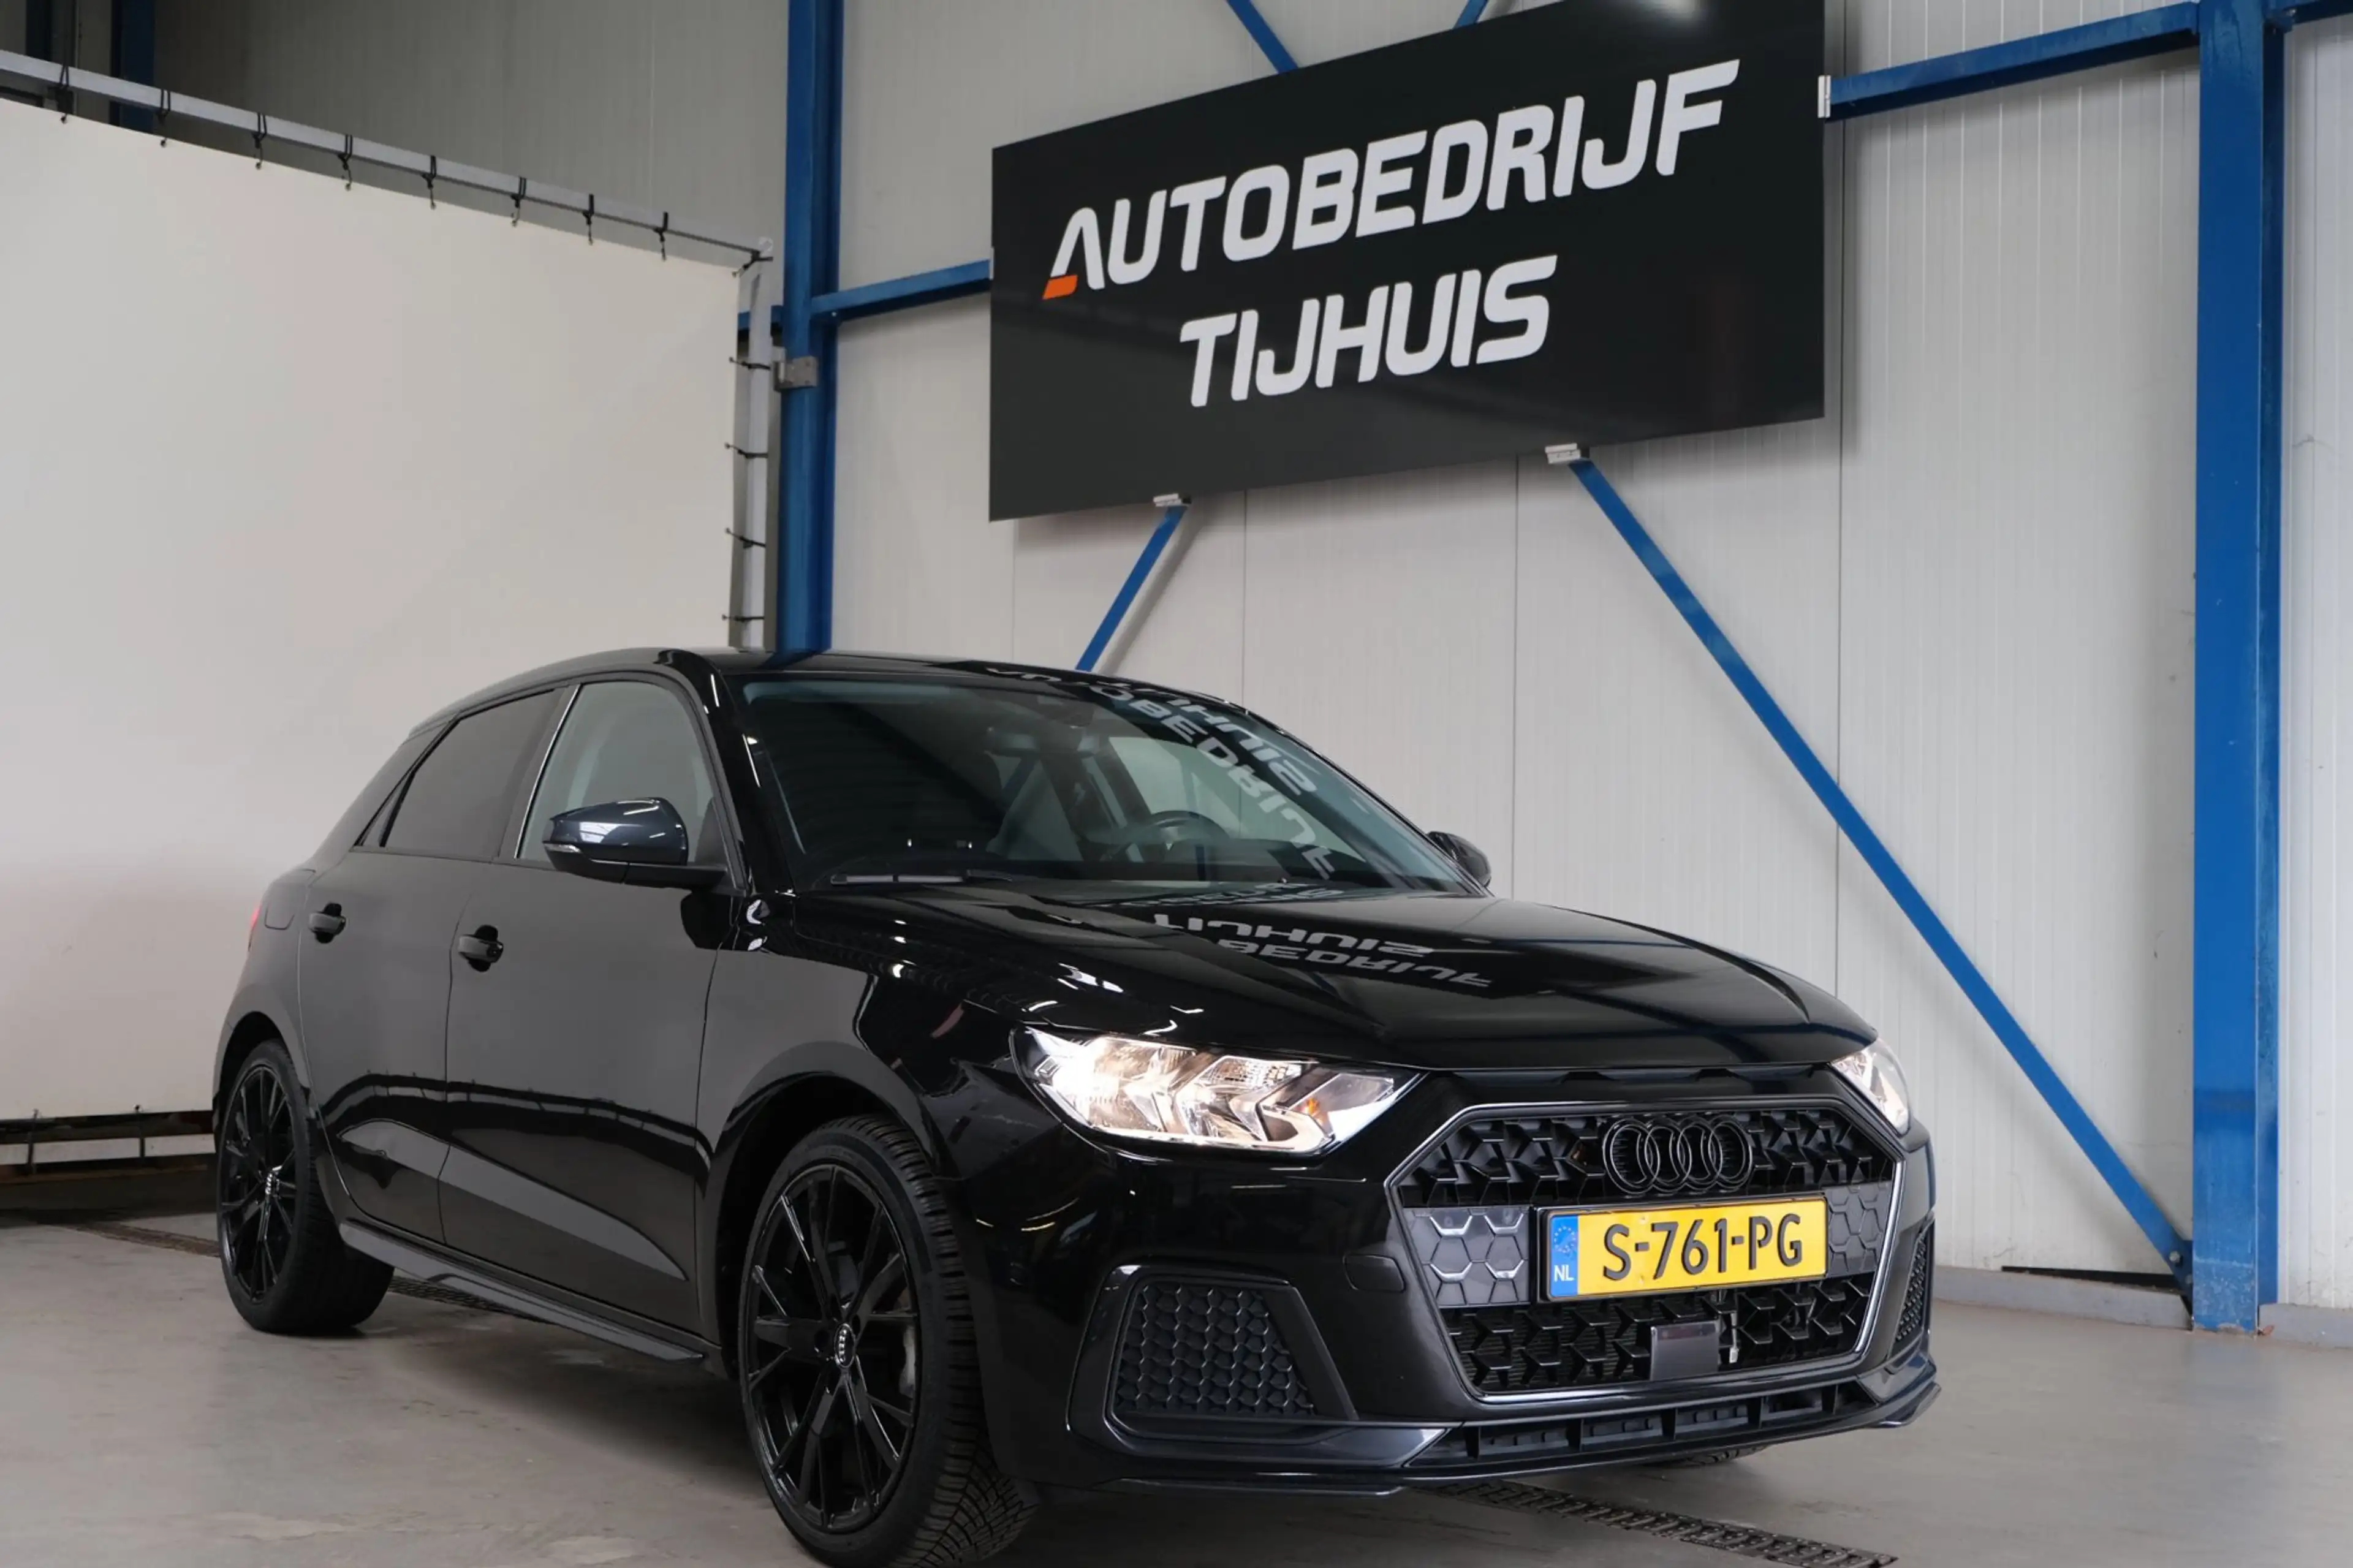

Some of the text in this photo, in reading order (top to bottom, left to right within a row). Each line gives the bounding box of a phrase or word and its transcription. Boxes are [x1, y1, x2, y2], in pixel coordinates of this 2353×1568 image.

[1043, 59, 1740, 300] AUTOBEDRIJF
[1180, 254, 1558, 407] TIJHUIS
[1553, 1264, 1574, 1282] NL
[1602, 1213, 1802, 1281] S-761-PG
